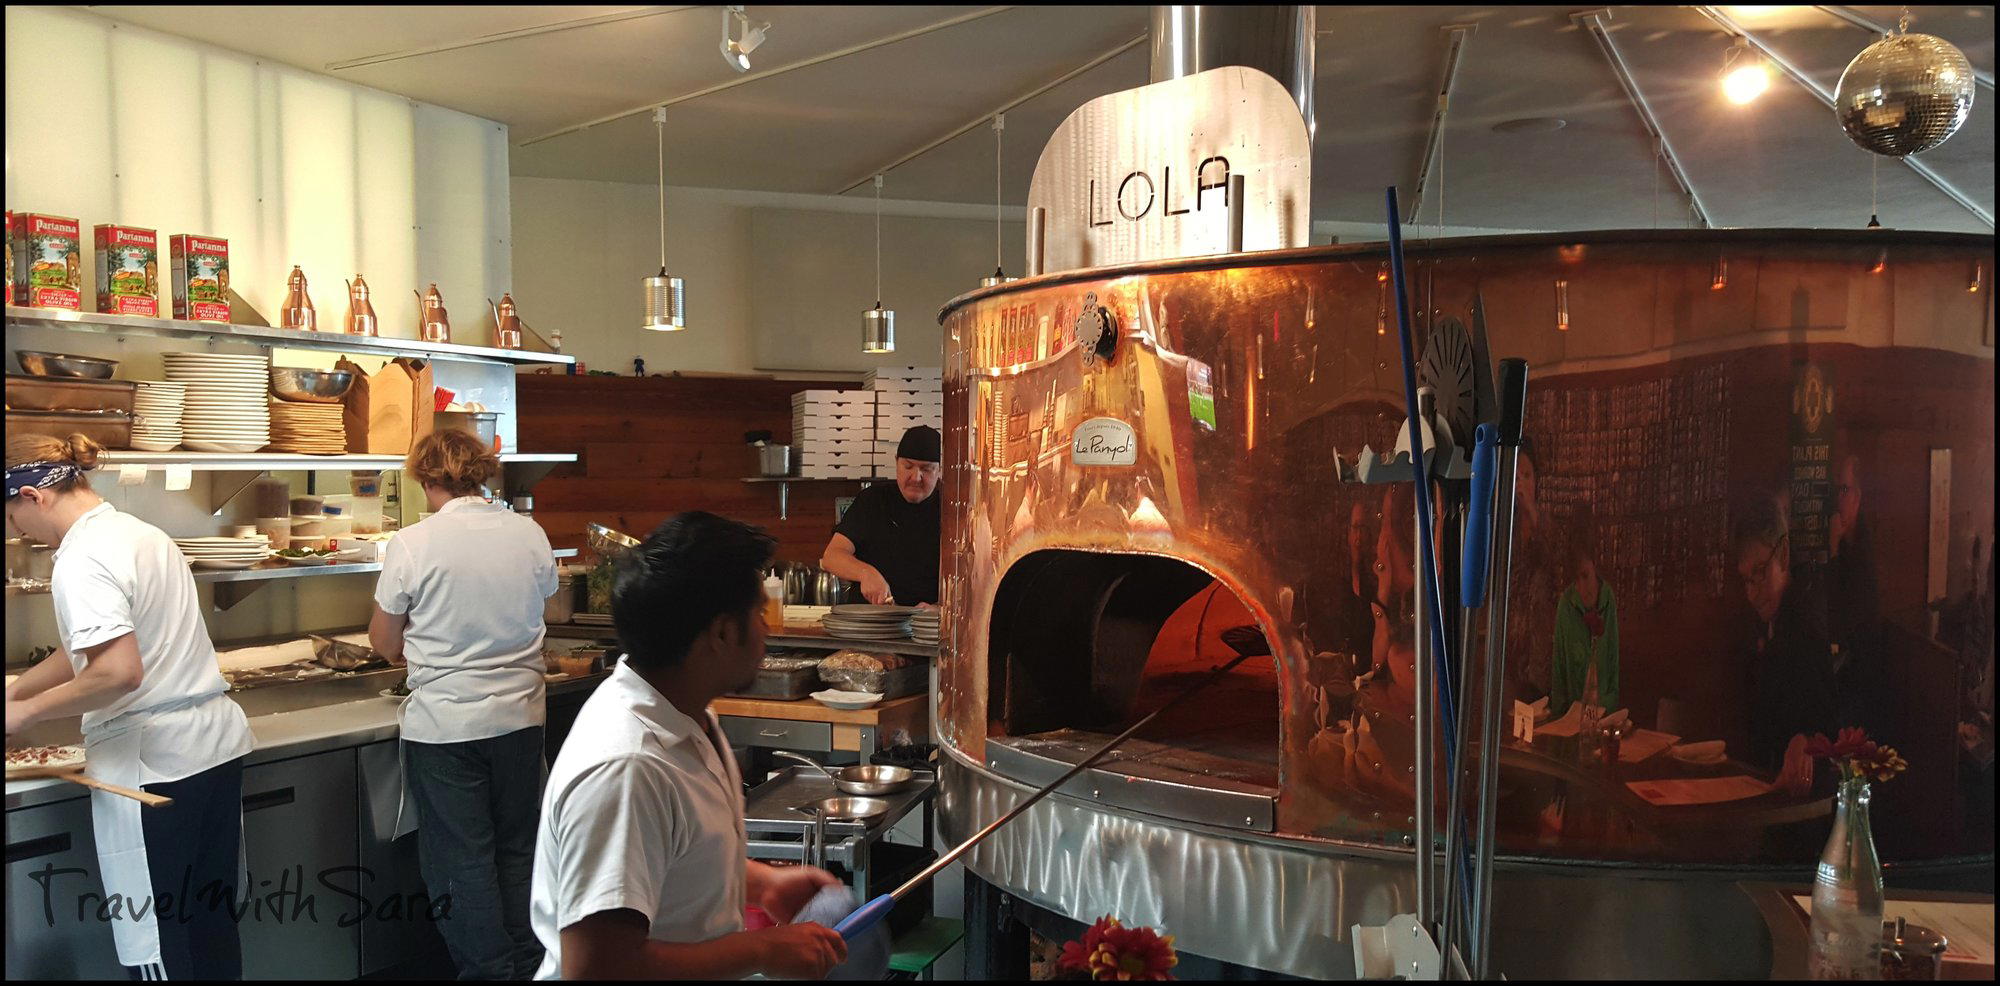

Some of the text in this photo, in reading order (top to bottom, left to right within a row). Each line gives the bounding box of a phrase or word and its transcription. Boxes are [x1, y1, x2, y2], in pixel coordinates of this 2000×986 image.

[1090, 156, 1230, 228] LOLA
[1076, 434, 1130, 461] Le Panyol
